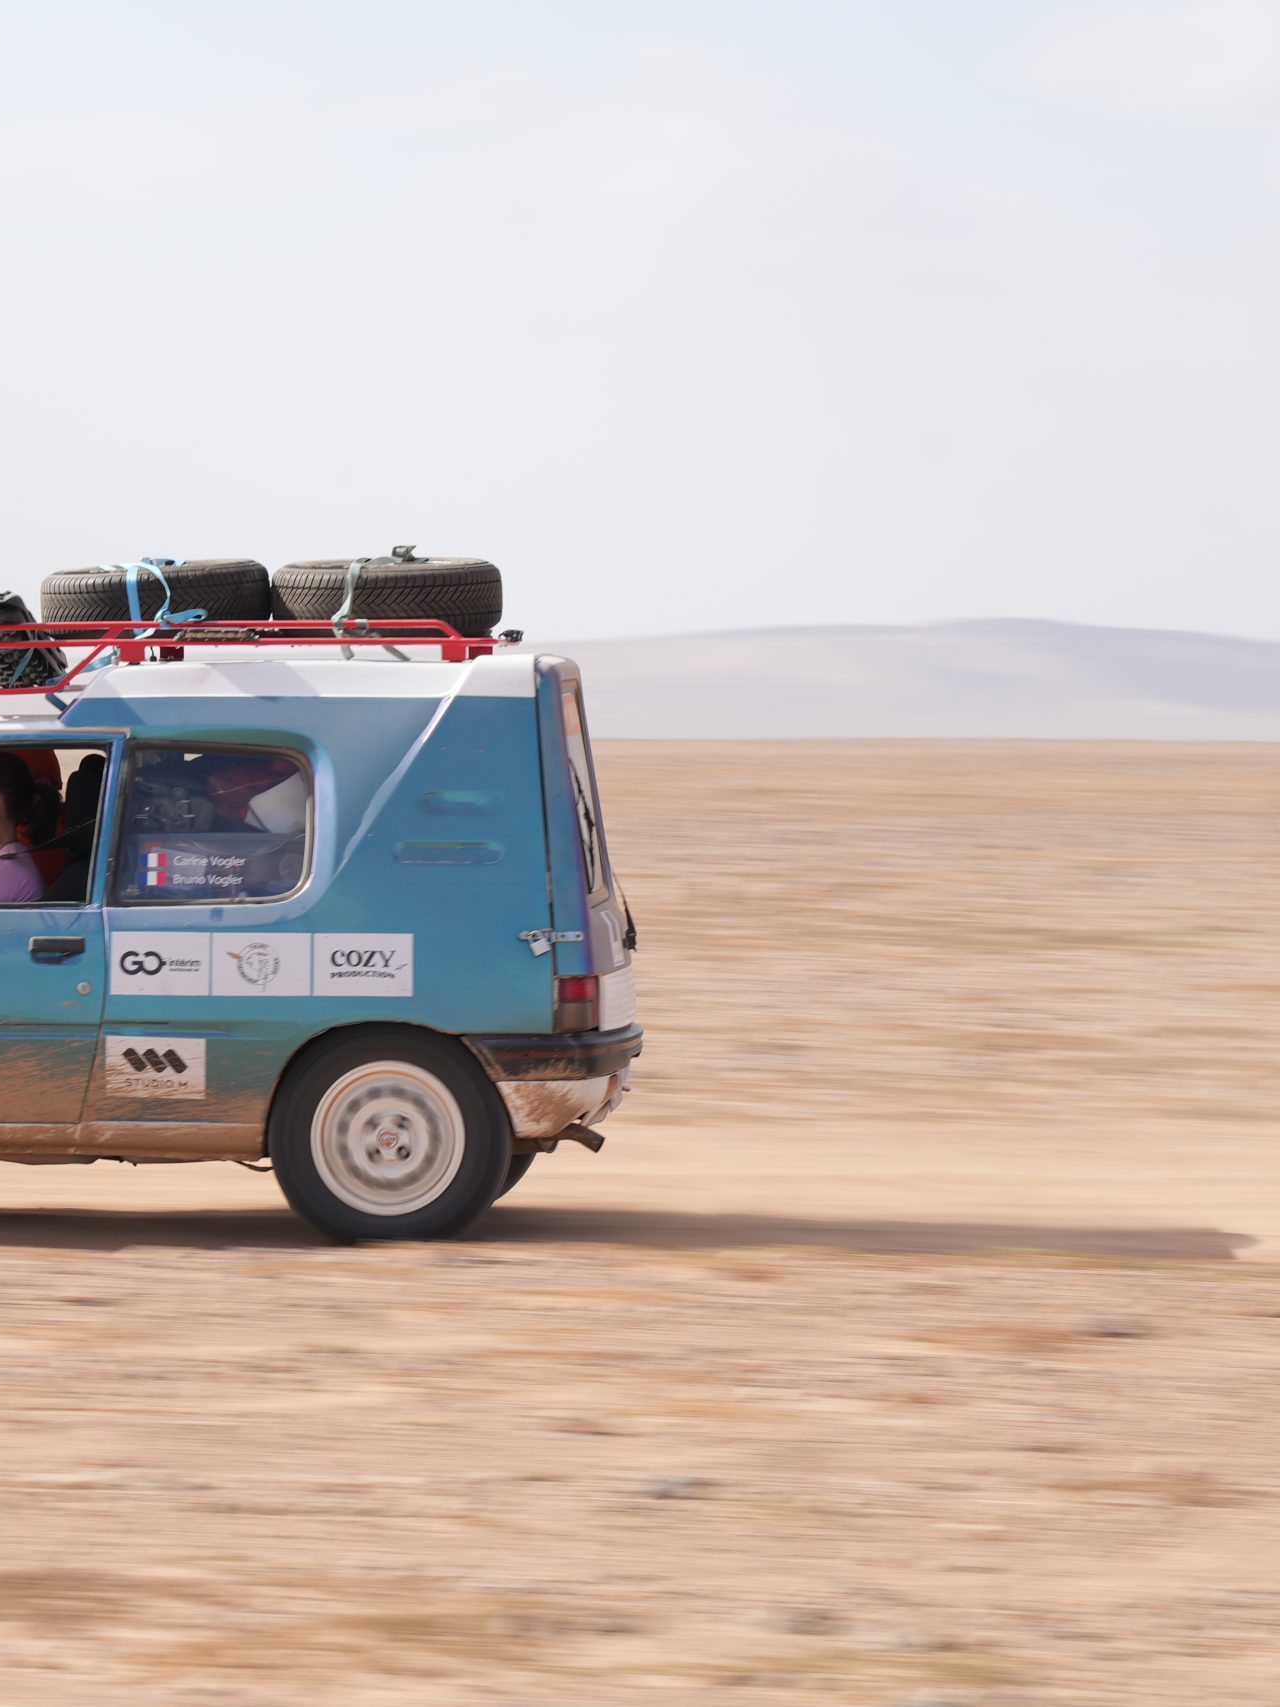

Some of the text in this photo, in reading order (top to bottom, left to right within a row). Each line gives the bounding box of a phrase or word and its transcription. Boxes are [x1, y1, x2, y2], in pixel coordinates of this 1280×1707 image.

[173, 855, 246, 869] Carine Vogler
[173, 874, 243, 887] Bruno Vogler
[330, 949, 396, 968] COZY
[330, 970, 395, 979] PRODUCTION
